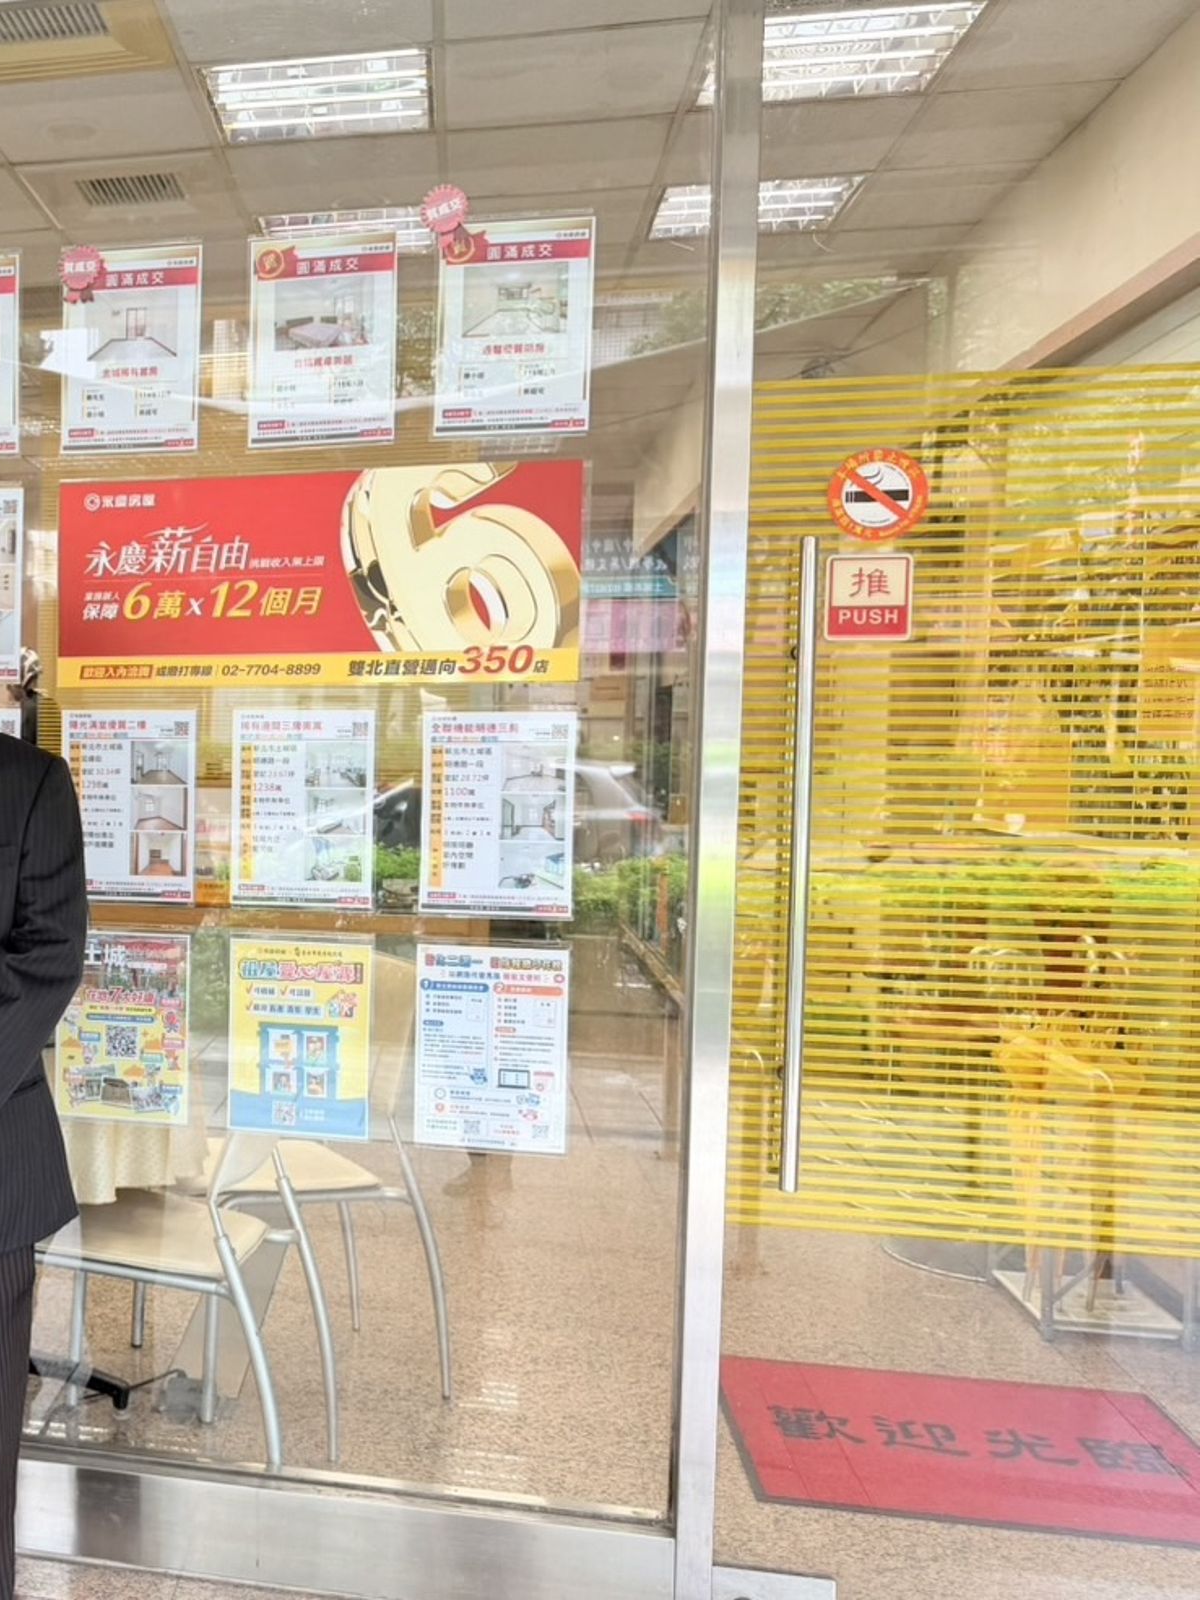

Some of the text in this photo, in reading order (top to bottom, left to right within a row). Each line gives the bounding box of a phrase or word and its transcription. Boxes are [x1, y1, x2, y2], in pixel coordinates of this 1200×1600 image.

[101, 493, 155, 508] 永慶房屋
[84, 522, 250, 577] 永慶薪自由
[849, 567, 891, 597] 推
[82, 602, 120, 621] 保障
[838, 608, 899, 625] PUSH
[221, 663, 321, 676] 02-7704-8899
[767, 1404, 1189, 1479] 歡迎光臨
